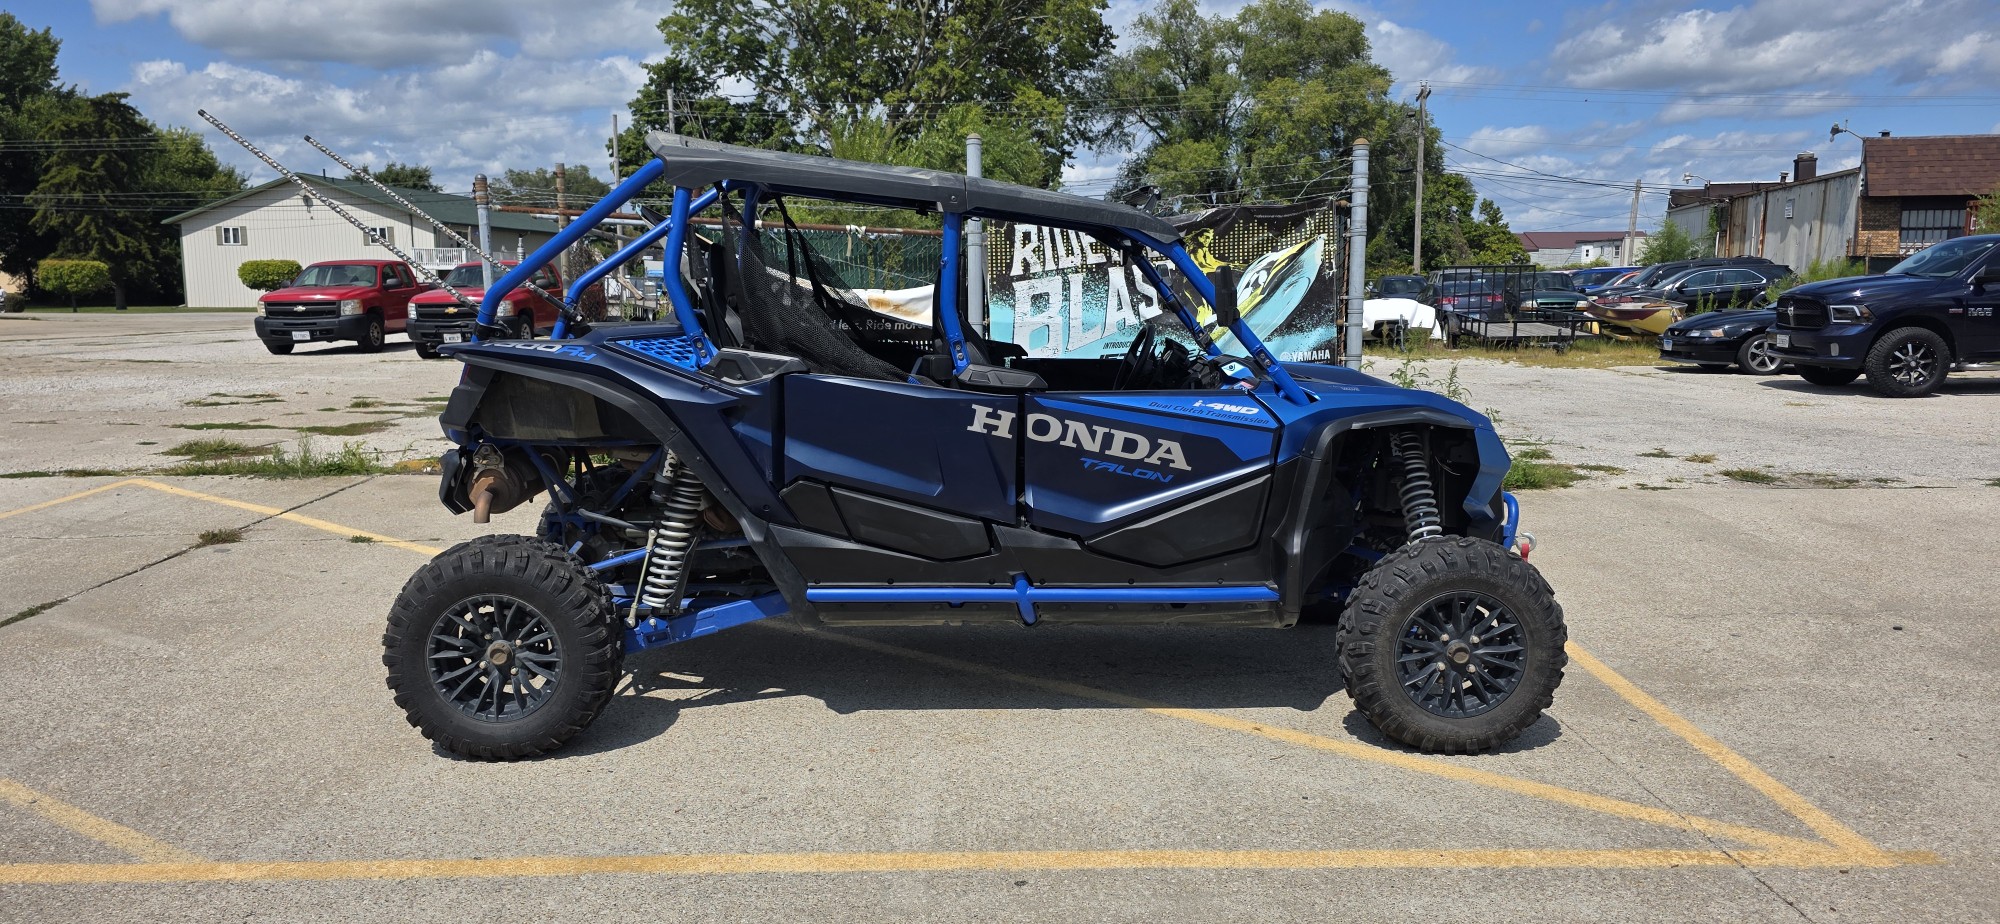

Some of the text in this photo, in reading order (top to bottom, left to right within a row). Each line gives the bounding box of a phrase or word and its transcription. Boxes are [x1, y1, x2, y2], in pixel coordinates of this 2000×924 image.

[1010, 224, 1107, 276] RIDE
[1012, 260, 1176, 358] BLAS
[866, 319, 891, 330] Ride
[1292, 350, 1330, 362] YAMAHA
[1149, 401, 1269, 425] Dual Clutch Transmission
[967, 404, 1192, 471] HONDA
[1389, 432, 1403, 457] FOX
[1080, 457, 1175, 483] TALON
